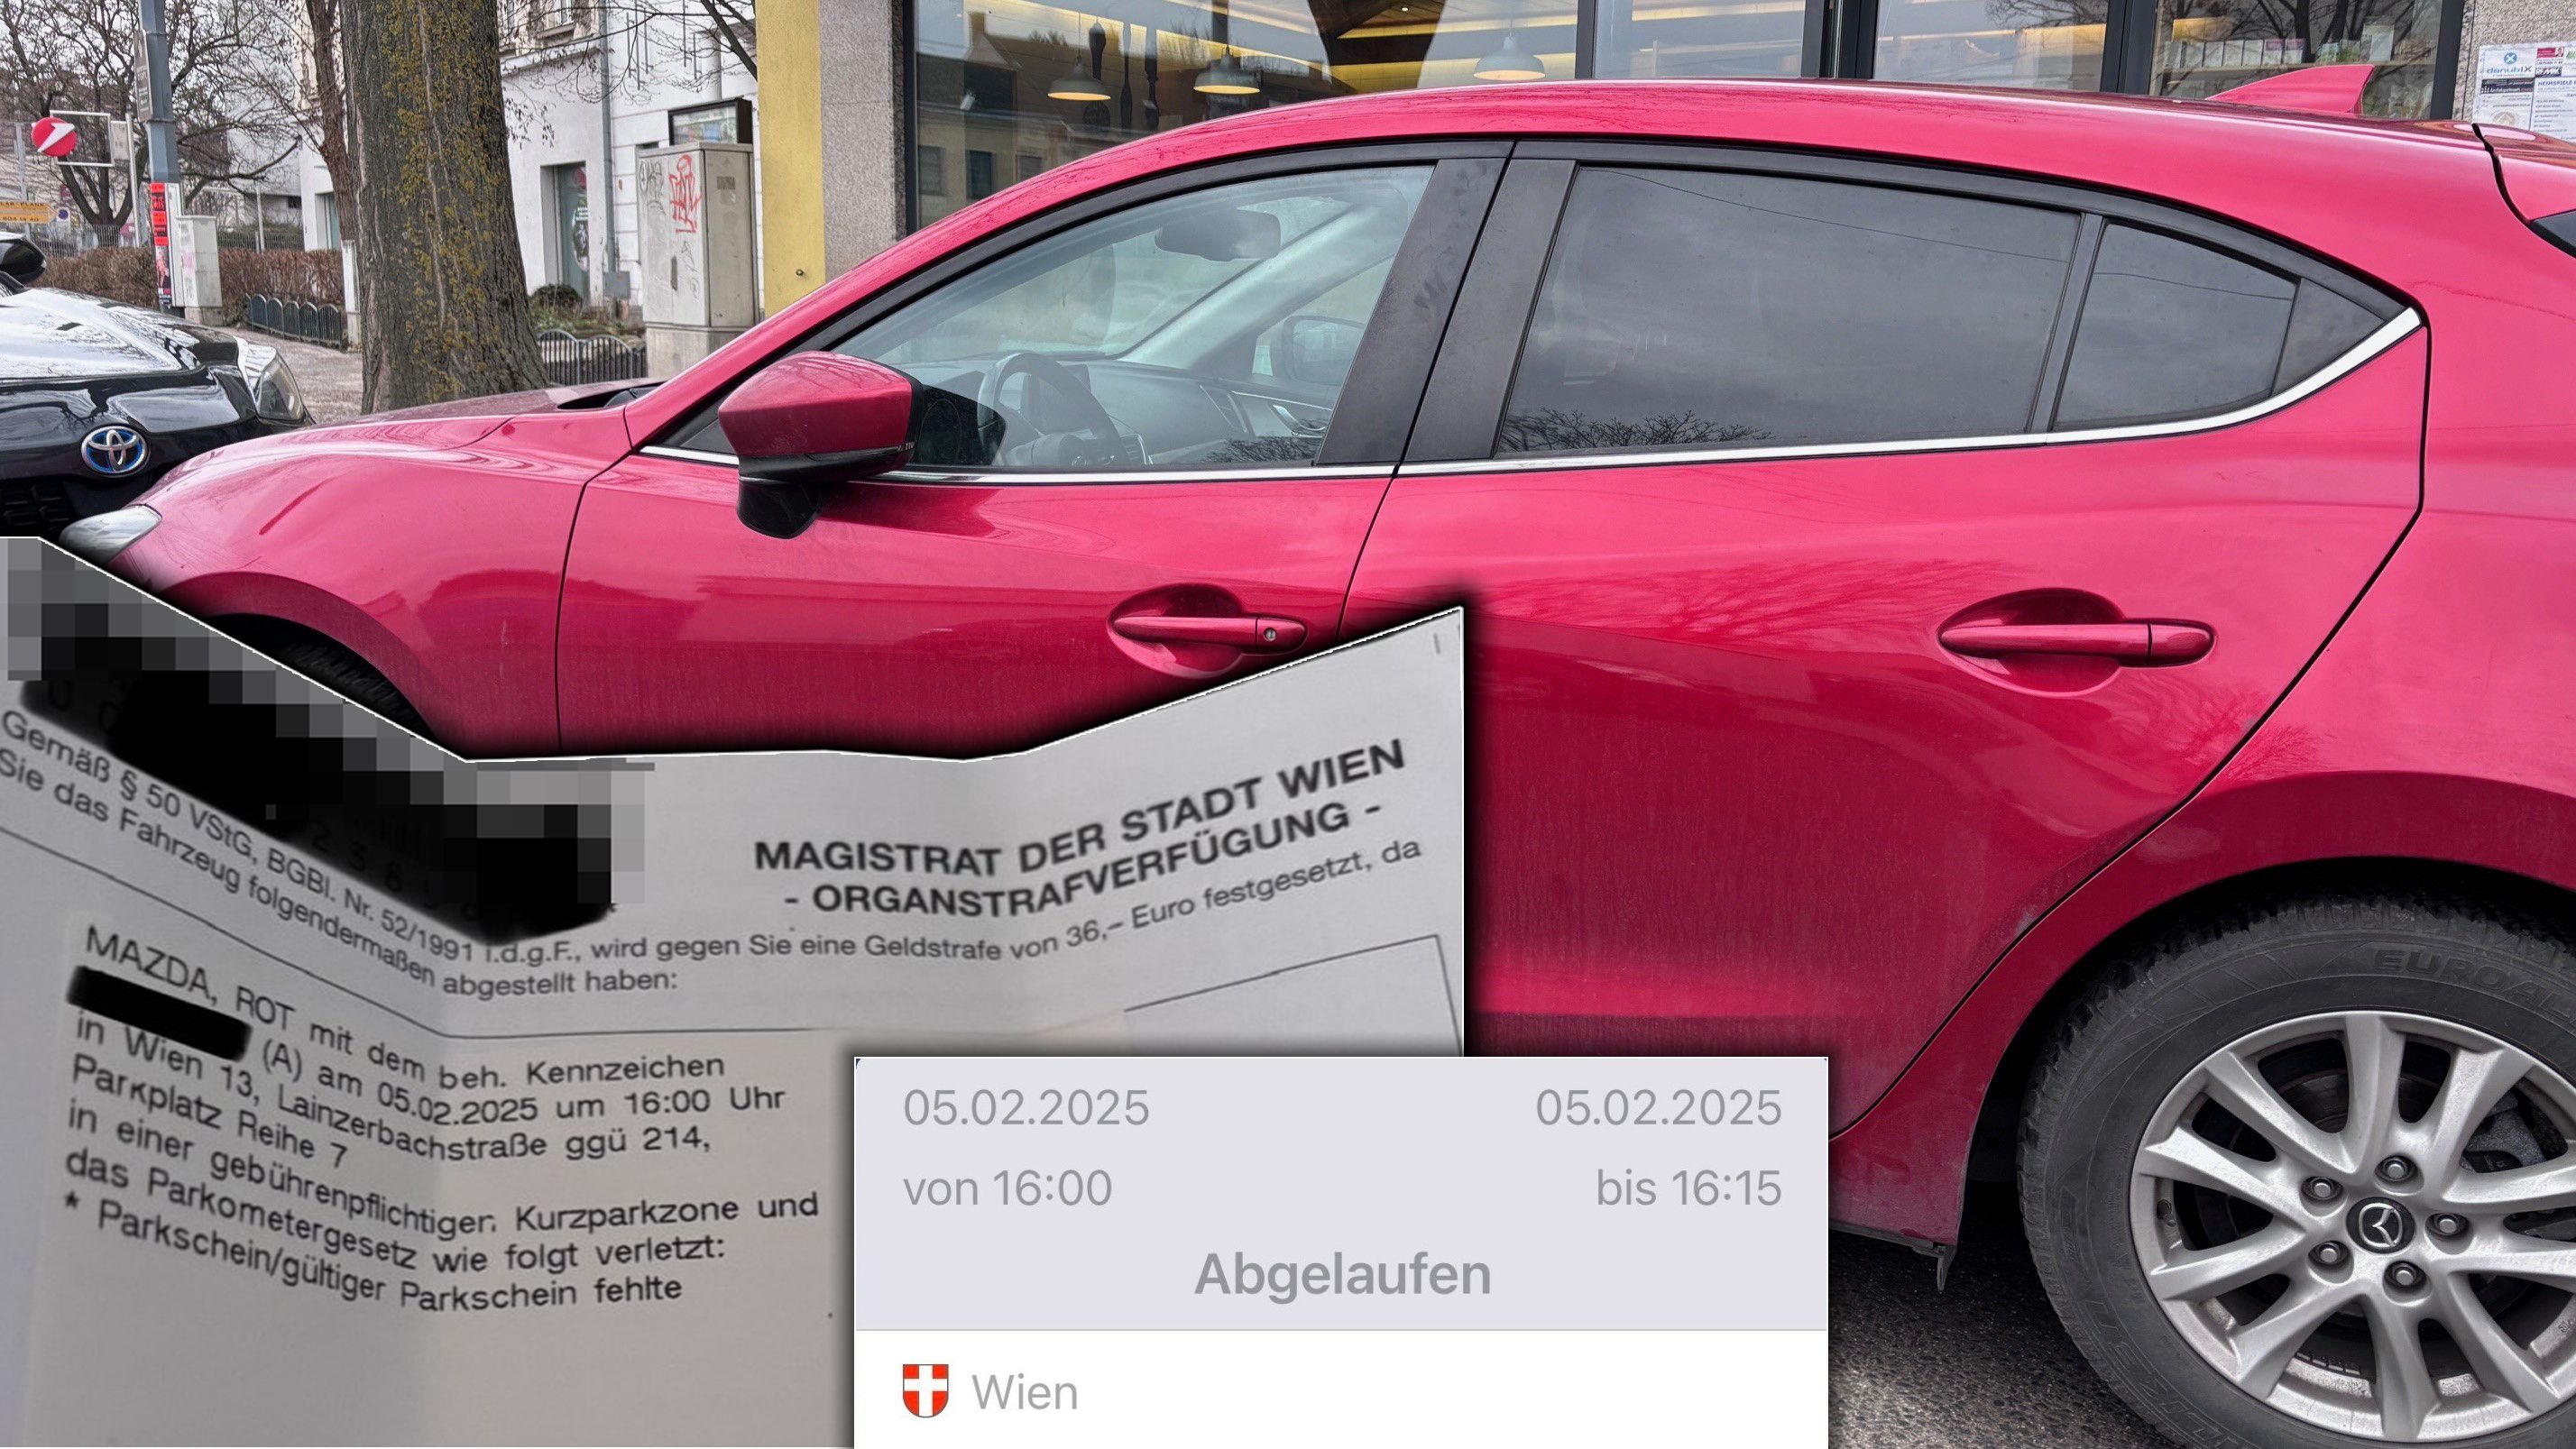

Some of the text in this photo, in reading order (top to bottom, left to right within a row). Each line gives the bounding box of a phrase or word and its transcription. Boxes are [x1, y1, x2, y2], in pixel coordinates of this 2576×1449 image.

[3, 711, 110, 783] Gemäß
[120, 770, 138, 802] §
[146, 784, 180, 817] 50
[189, 802, 258, 865] VStG,
[267, 848, 336, 902] BGBl.
[344, 888, 373, 922] Nr.
[381, 909, 473, 963] 52/1991
[591, 938, 647, 958] wird
[656, 940, 740, 961] gegen
[750, 934, 792, 956] Sie
[800, 935, 856, 955] eine
[865, 935, 1002, 960] Geldstrafe
[1010, 936, 1059, 959] von
[1131, 901, 1195, 931] Euro
[1205, 850, 1373, 909] festgesetzt,
[1381, 837, 1421, 865] da
[756, 738, 1406, 876] MAGISTRAT DER STADT WIEN
[813, 801, 1349, 918] ORGANSTRAFVERFÜGUNG
[0, 747, 677, 1000] Sie das Fahrzeug folgendermaßen abgestellt haben:
[87, 924, 724, 1089] MAZDA, ROT mit dem beh. Kennzeichen
[74, 1053, 348, 1168] Parkplatz Reihe 7
[78, 1009, 711, 1161] in Wien 13, Lainzerbachstraße ggü 214,
[262, 1039, 787, 1125] (A) am 05.02.2025 um 16:00 Uhr
[905, 1089, 1149, 1125] 05.02.2025
[1537, 1089, 1781, 1125] 05.02.2025
[67, 1148, 726, 1274] das Parkometergesetz wie folgt verletzt:
[69, 1098, 97, 1133] in
[117, 1118, 194, 1160] einer
[516, 1197, 740, 1233] Kurzparkzone
[759, 1190, 819, 1218] und
[903, 1169, 1111, 1206] von 16:00
[1598, 1169, 1781, 1206] bis 16:15
[98, 1198, 386, 1301] Parkschein/gültiger
[400, 1281, 577, 1311] Parkschein
[593, 1277, 683, 1304] fehlte
[1194, 1252, 1490, 1305] Abgelaufen
[971, 1372, 1077, 1410] Wien
